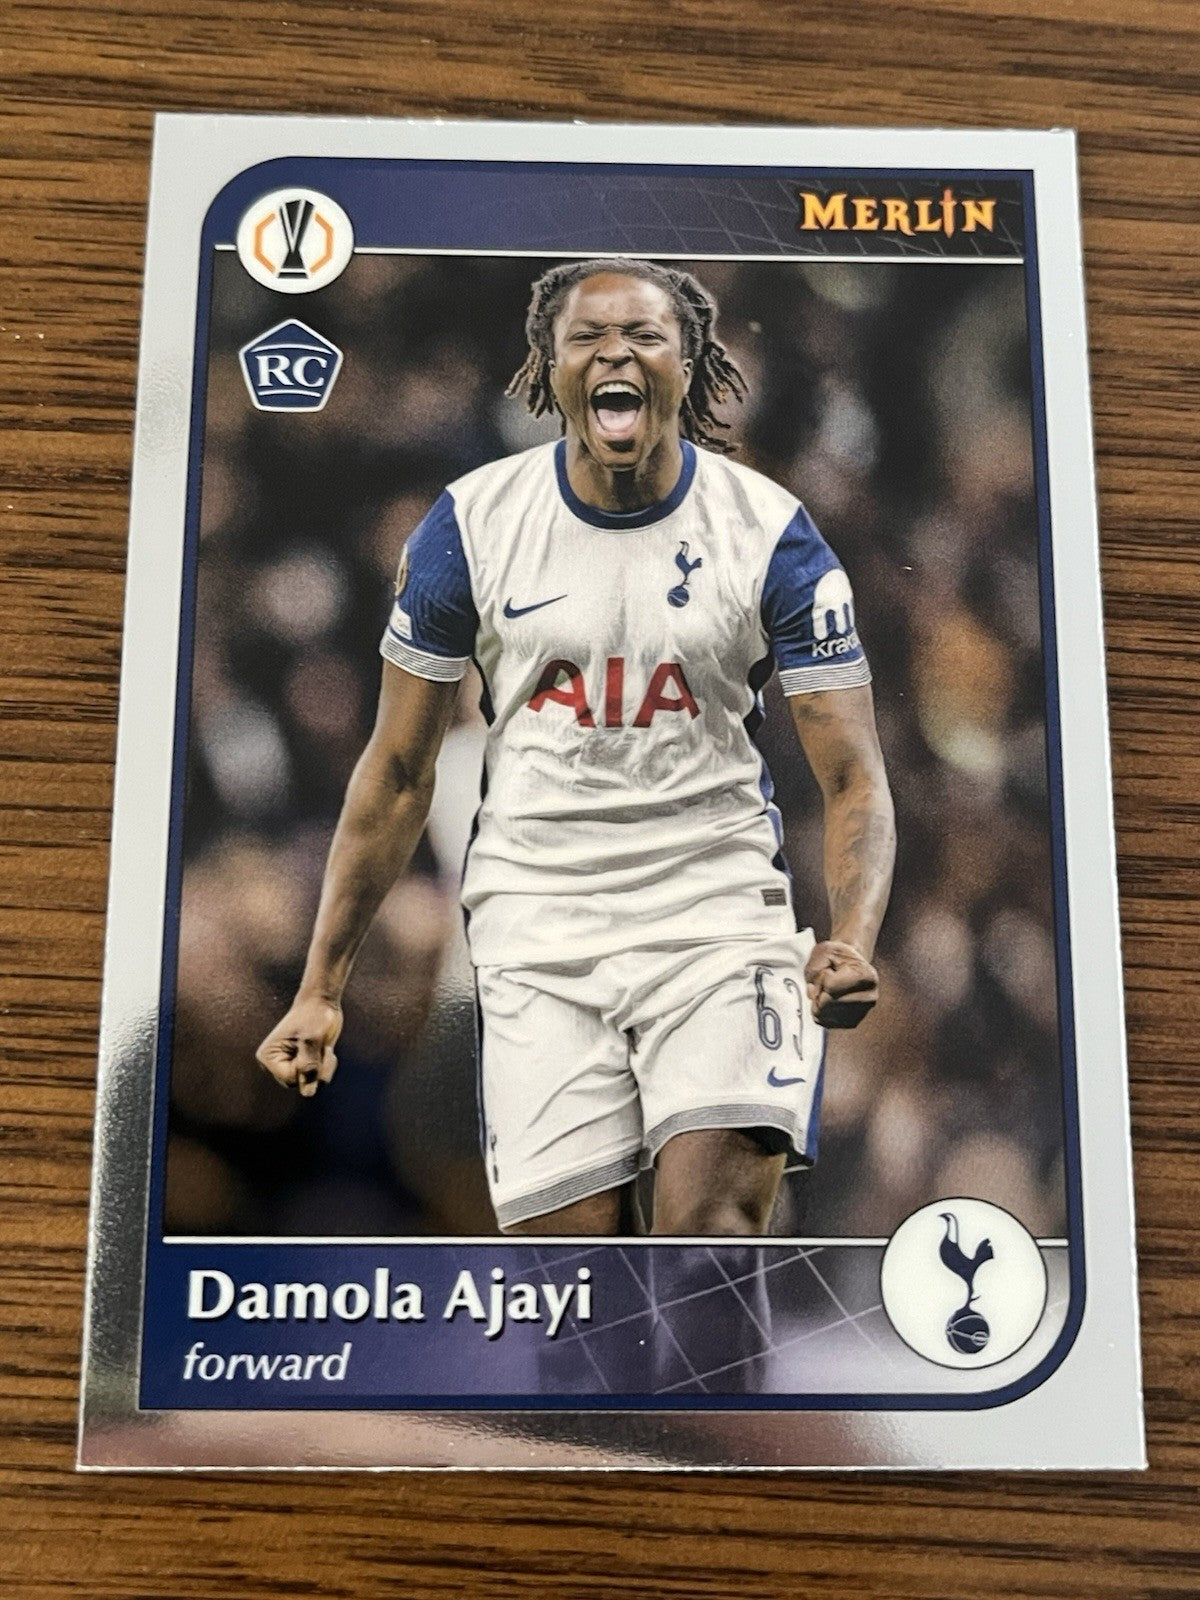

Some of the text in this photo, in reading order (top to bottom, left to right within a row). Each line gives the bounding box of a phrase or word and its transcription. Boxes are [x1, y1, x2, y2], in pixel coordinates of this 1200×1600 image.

[800, 188, 996, 238] MERLIN
[256, 355, 327, 387] RC
[527, 657, 700, 728] AIA
[187, 1267, 592, 1337] Damola Ajayi
[183, 1341, 352, 1381] forward
